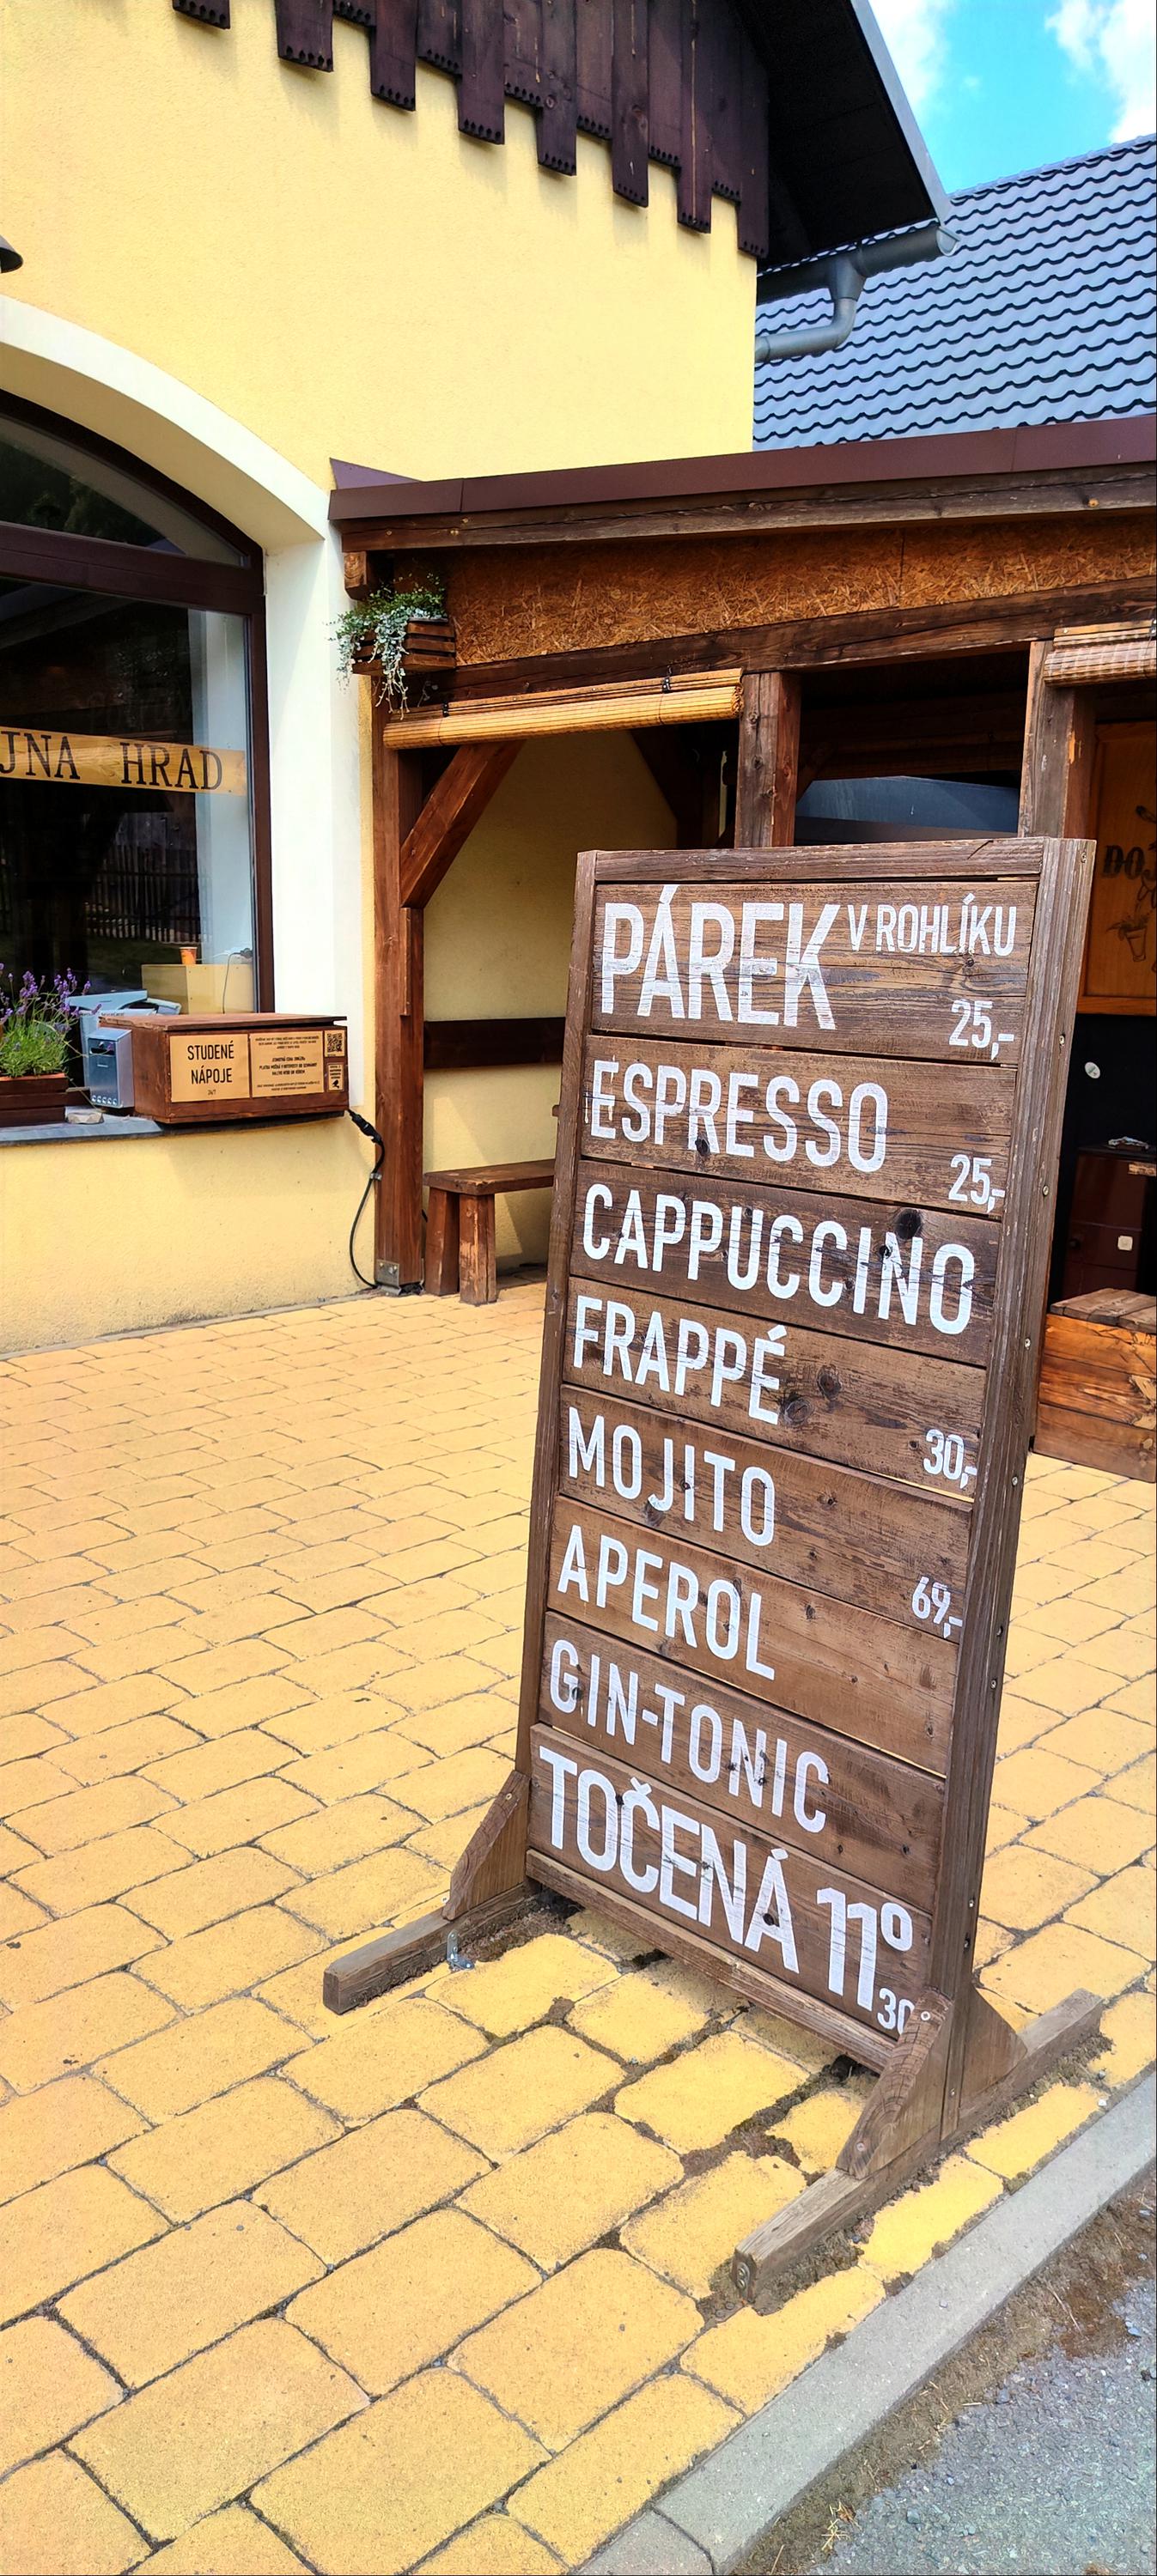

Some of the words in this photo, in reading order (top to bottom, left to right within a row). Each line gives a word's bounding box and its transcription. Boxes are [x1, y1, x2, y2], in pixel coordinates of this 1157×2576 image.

[119, 741, 222, 790] HRAD
[601, 884, 841, 1030] PÁREK
[846, 903, 869, 952] V
[875, 892, 1017, 957] ROHLÍKU
[187, 1040, 234, 1060] STUDENÉ
[191, 1065, 233, 1084] NÁPOJE
[948, 998, 1015, 1060] 25,-
[589, 1059, 889, 1173] ESPRESSO
[582, 1183, 975, 1335] CAPPUCCINO
[573, 1295, 788, 1425] FRAPPÉ
[568, 1406, 776, 1546] MOJITO
[557, 1524, 775, 1680] APEROL
[550, 1639, 830, 1833] GIN-TONIC
[539, 1745, 800, 1974] TOČENÁ
